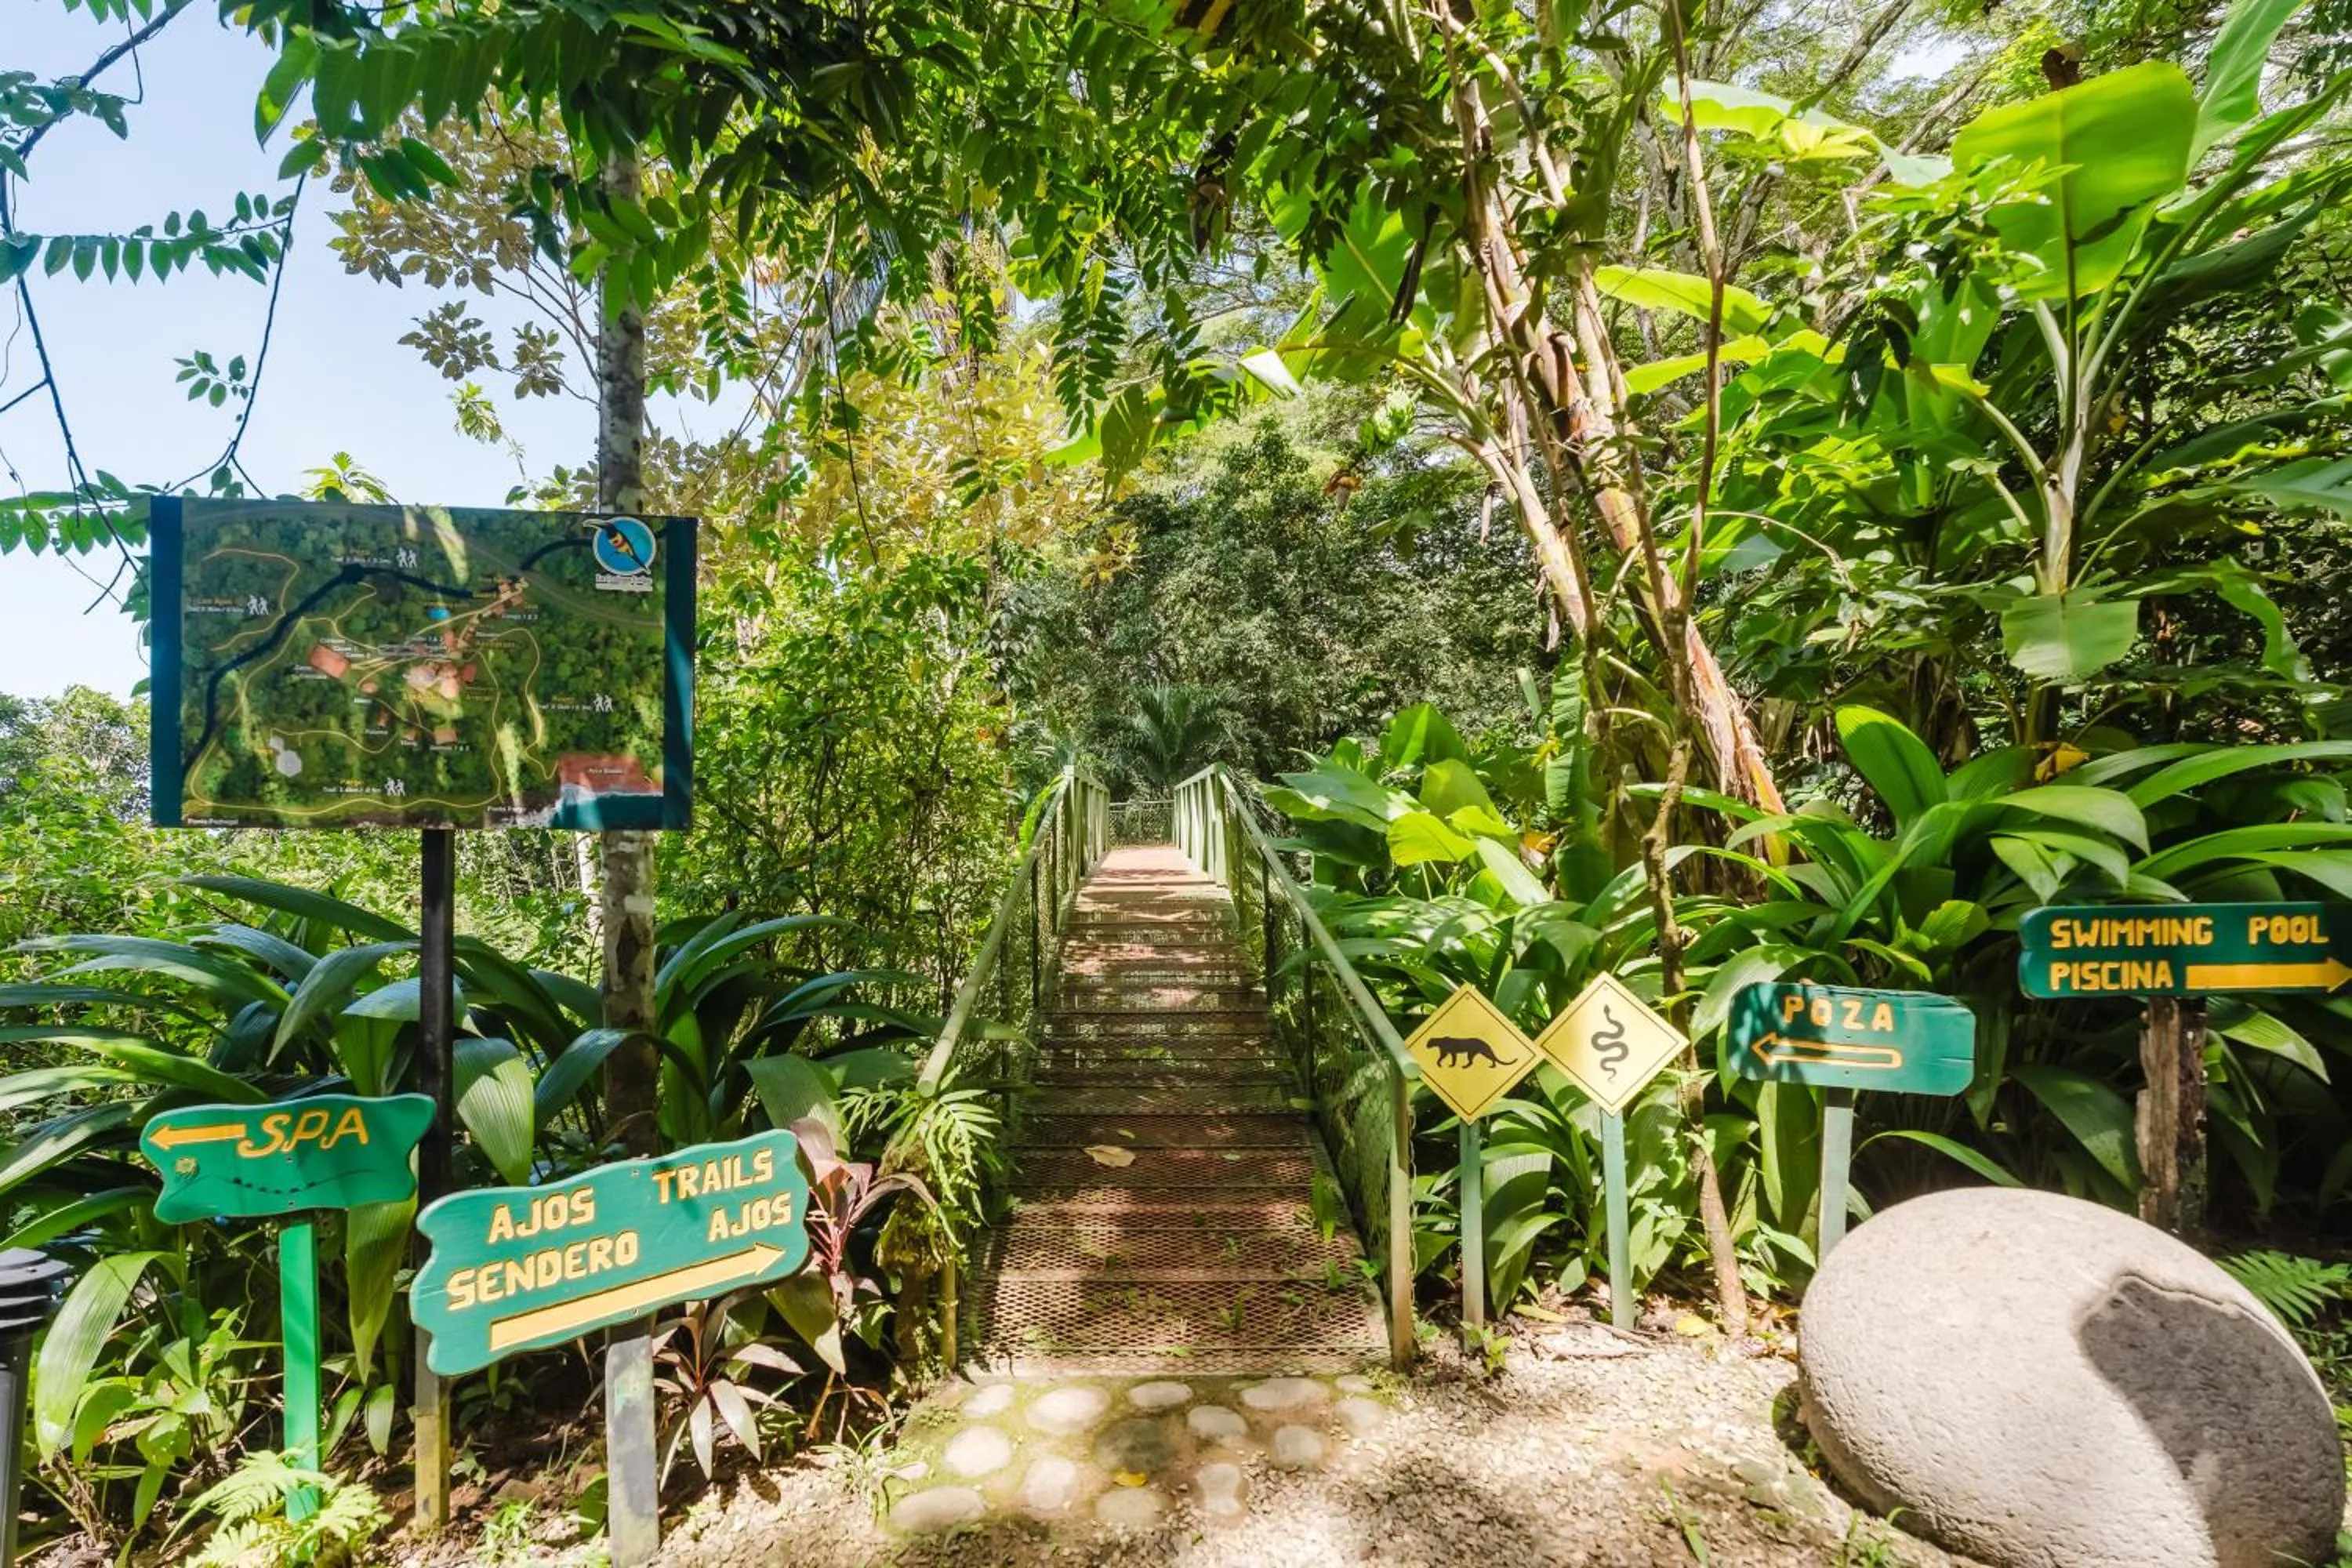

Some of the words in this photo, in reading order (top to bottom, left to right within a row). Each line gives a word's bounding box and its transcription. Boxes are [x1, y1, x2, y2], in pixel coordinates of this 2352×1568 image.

[2049, 916, 2214, 949] SWIMMING
[2247, 915, 2329, 945] POOL
[2049, 960, 2174, 991] PISCINA
[1784, 995, 1895, 1033] POZA
[237, 1106, 369, 1158] SPA
[487, 1185, 596, 1244] AJOS
[652, 1147, 773, 1205] TRAILS
[446, 1229, 639, 1312] SENDERO
[708, 1191, 791, 1243] AJOS
